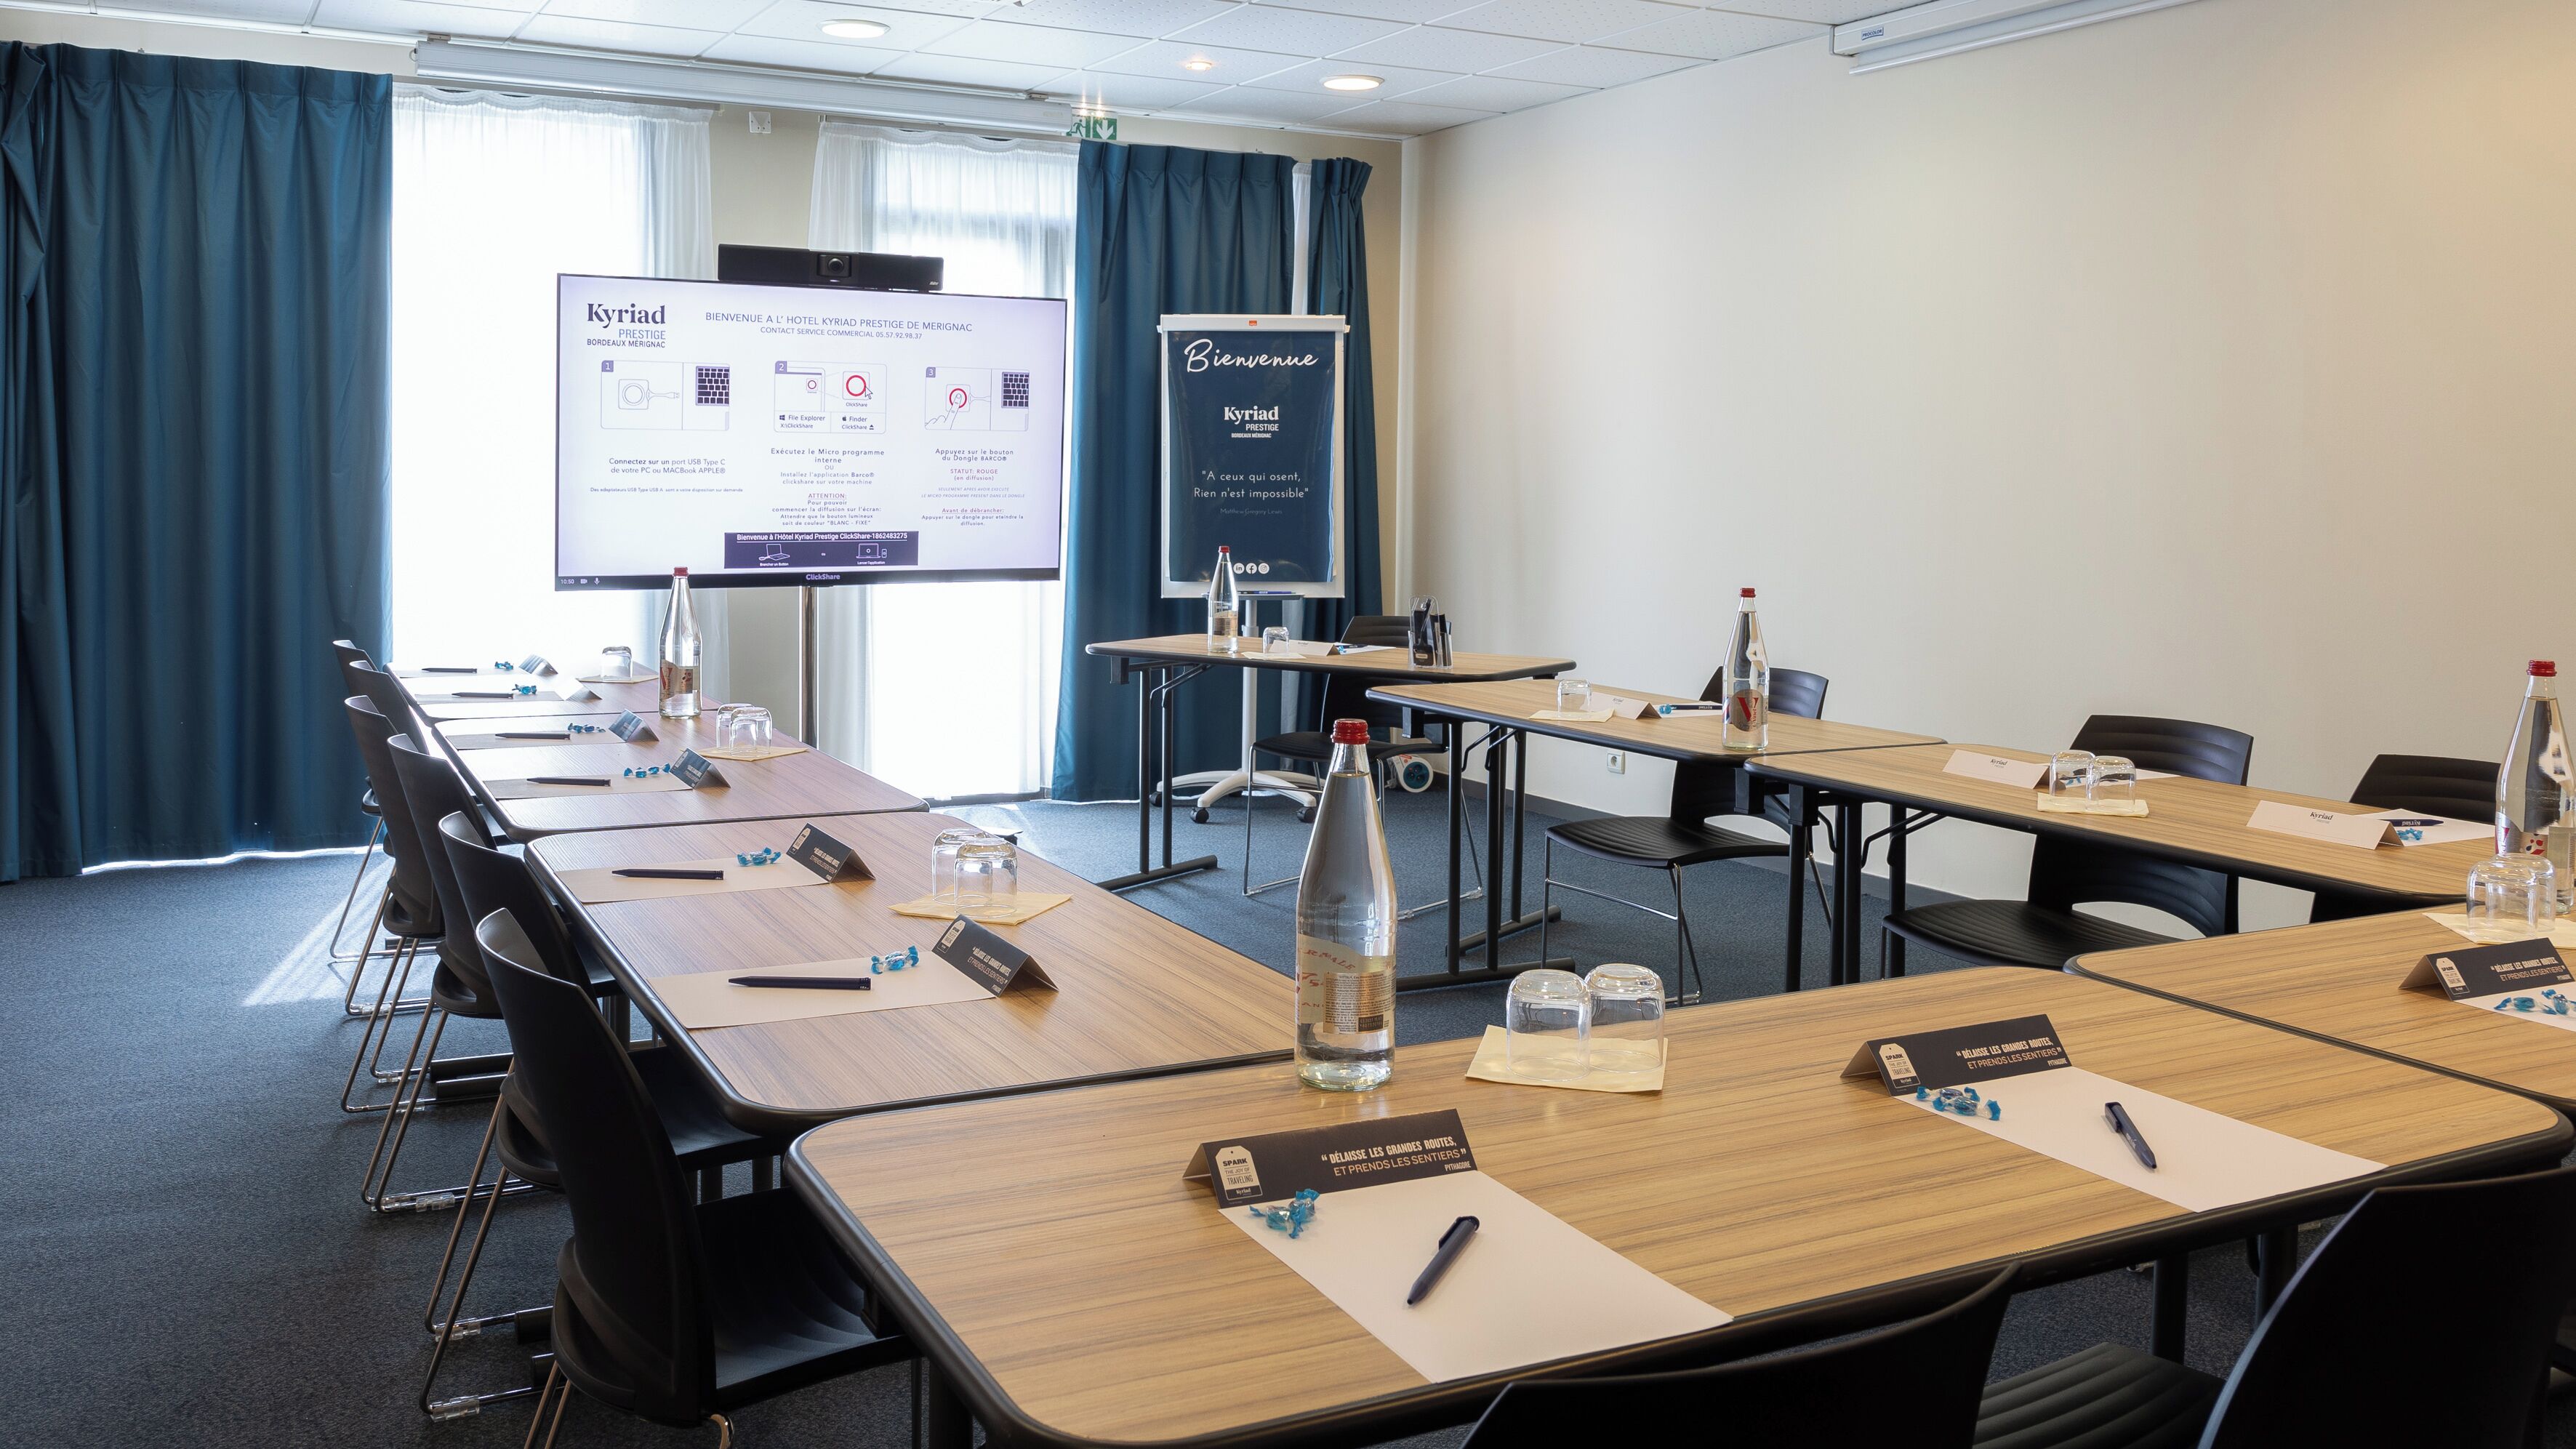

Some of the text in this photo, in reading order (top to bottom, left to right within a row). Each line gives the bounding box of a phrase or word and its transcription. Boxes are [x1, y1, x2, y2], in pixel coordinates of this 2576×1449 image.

[1862, 28, 1882, 37] PROCOLOR
[587, 302, 666, 329] Kyriad
[705, 312, 763, 323] BIENVENUE
[766, 315, 774, 324] A
[787, 316, 819, 326] HOTEL
[822, 317, 856, 327] KYRIAD
[859, 318, 904, 329] PRESTIGE
[907, 320, 920, 329] DE
[922, 321, 973, 332] MERIGNAC
[619, 329, 666, 340] PRESTIGE
[761, 326, 923, 340] CONTACT SERVICE COMMERCIAL 05.57.92.98.37
[587, 338, 665, 348] BORDEAUX MÉRIGNAC
[1184, 338, 1319, 373] Bienvenue
[1224, 405, 1280, 425] Kyriad
[1202, 470, 1216, 481] "A
[1248, 472, 1266, 483] qui
[1269, 472, 1301, 483] osent,
[1194, 487, 1309, 500] Rien n'est impossible"
[2309, 811, 2334, 821] Kyriad
[2507, 971, 2530, 980] PRENDS
[1989, 1045, 2002, 1055] LES
[2002, 1040, 2029, 1053] GRANDES
[2029, 1037, 2054, 1048] ROUTES,
[1978, 1056, 2008, 1068] PRENDS
[2007, 1053, 2022, 1063] LES
[1368, 1147, 1384, 1158] LES
[1386, 1141, 1423, 1156] GRANDES
[1425, 1136, 1457, 1150] ROUTES,
[1223, 1157, 1248, 1167] SPARK
[1333, 1165, 1347, 1176] ET
[1349, 1161, 1390, 1175] PRENDS
[1392, 1156, 1411, 1168] LES
[1445, 1160, 1472, 1172] PYTHAGORE
[1227, 1174, 1253, 1185] TRAVELING
